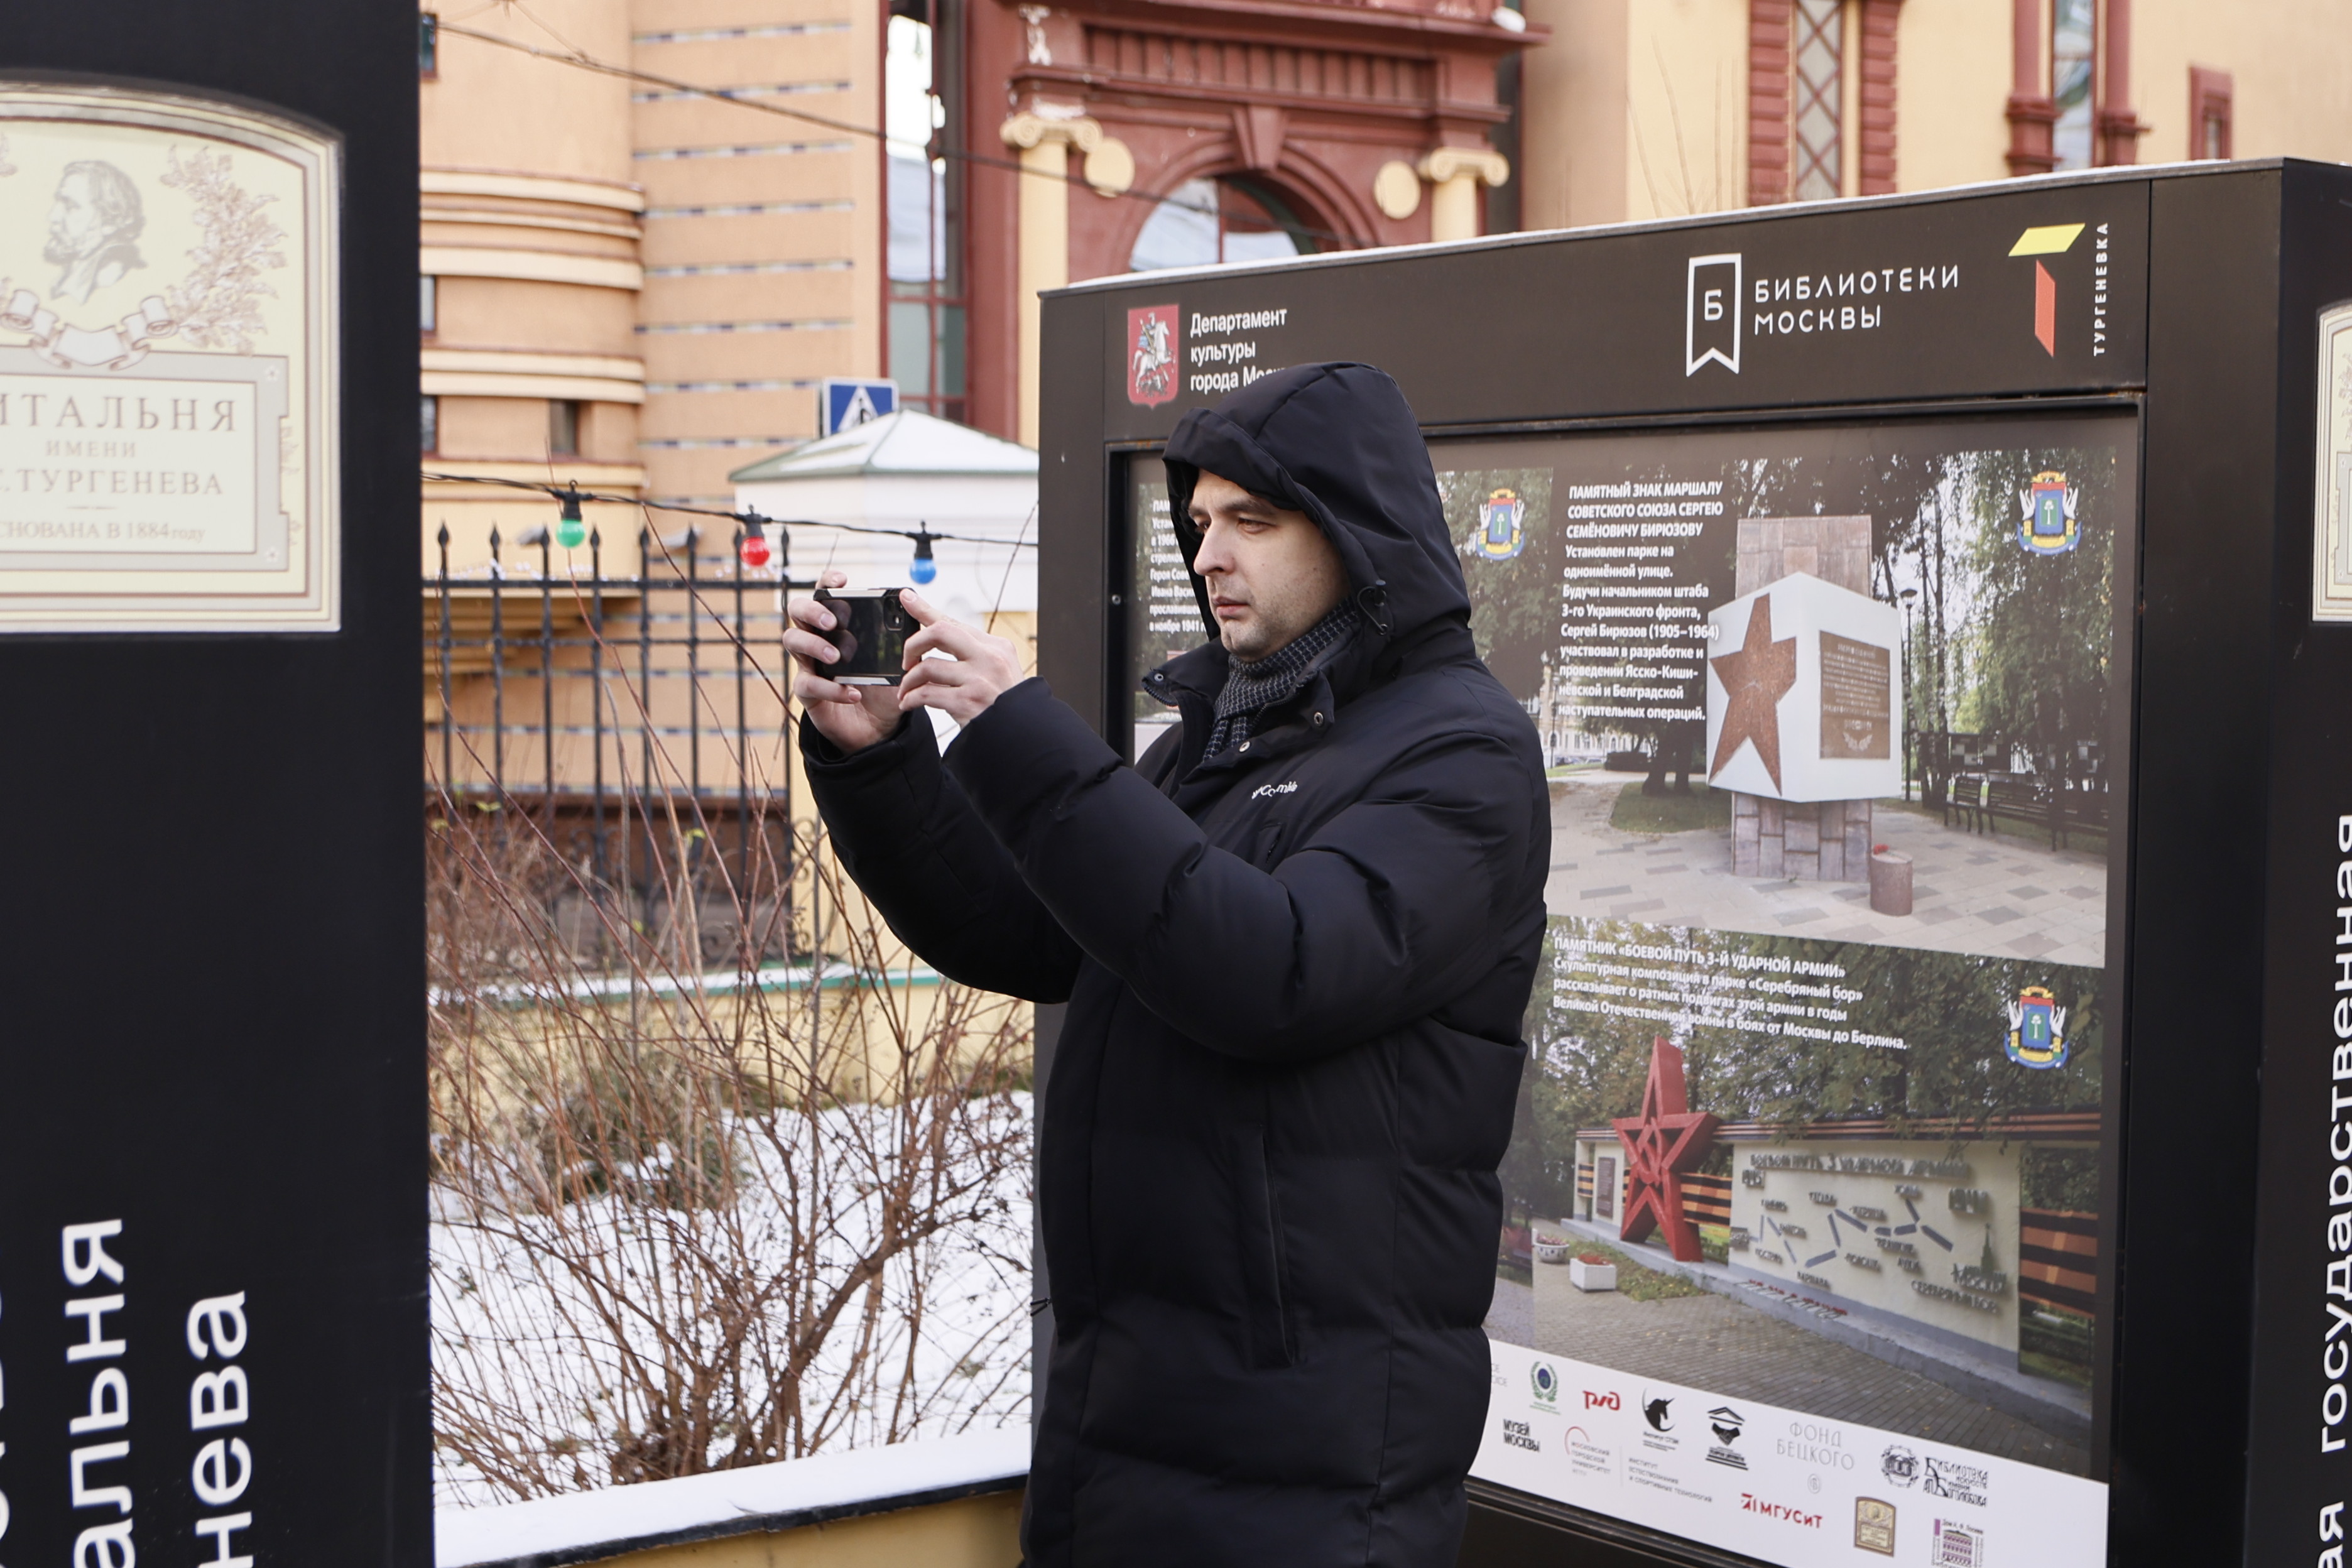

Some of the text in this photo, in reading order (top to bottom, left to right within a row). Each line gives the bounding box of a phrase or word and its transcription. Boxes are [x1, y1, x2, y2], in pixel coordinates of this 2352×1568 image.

[1755, 264, 1959, 303] БИБЛИОТЕКИ
[2093, 222, 2108, 356] ТУРГЕНЕВКА
[1190, 308, 1287, 338] Департамент
[1755, 305, 1881, 335] МОСКВЫ
[1190, 341, 1256, 368] культуры
[1190, 371, 1239, 395] города
[45, 440, 136, 458] ИМЕНИ
[1569, 481, 1723, 499] ПАМЯТНЫЙ ЗНАК МАРШАЛУ
[1567, 501, 1723, 519] СОВЕТСКОГО СОЮЗА СЕРГЕЮ
[107, 523, 121, 539] В
[1566, 521, 1703, 538] СЕМЁНОВИЧУ БИРЮЗОВУ
[1565, 545, 1674, 560] Установлен парке на
[1564, 564, 1674, 580] одноимённой улице.
[1562, 583, 1709, 601] Будучи начальником штаба
[1562, 603, 1701, 620] 3-го Украинского фронта,
[1560, 623, 1598, 640] Сергей
[1599, 624, 1647, 640] Бирюзов
[1560, 645, 1704, 661] участвовал в разработке и
[1559, 665, 1698, 679] проведении Ясско-Киши-
[1604, 685, 1611, 697] и
[1613, 684, 1684, 701] Белградской
[1558, 704, 1706, 722] наступательных операций.
[1554, 937, 1846, 978] ПАМЯТНИК «БОЕВОЙ ПУТЬ 3-Й УДАРНОЙ АРМИИ»
[1554, 957, 1863, 1003] Скульптурная композиция в парке «Серебряный бор»
[1554, 978, 1847, 1021] рассказывает о ратных подвигах этой армии в годы
[1553, 995, 1908, 1050] Великой Отечественной войны в боях от Москвы до Берлина.
[1789, 1422, 1842, 1447] ФОНД
[1777, 1439, 1854, 1471] БЕЦКОГО
